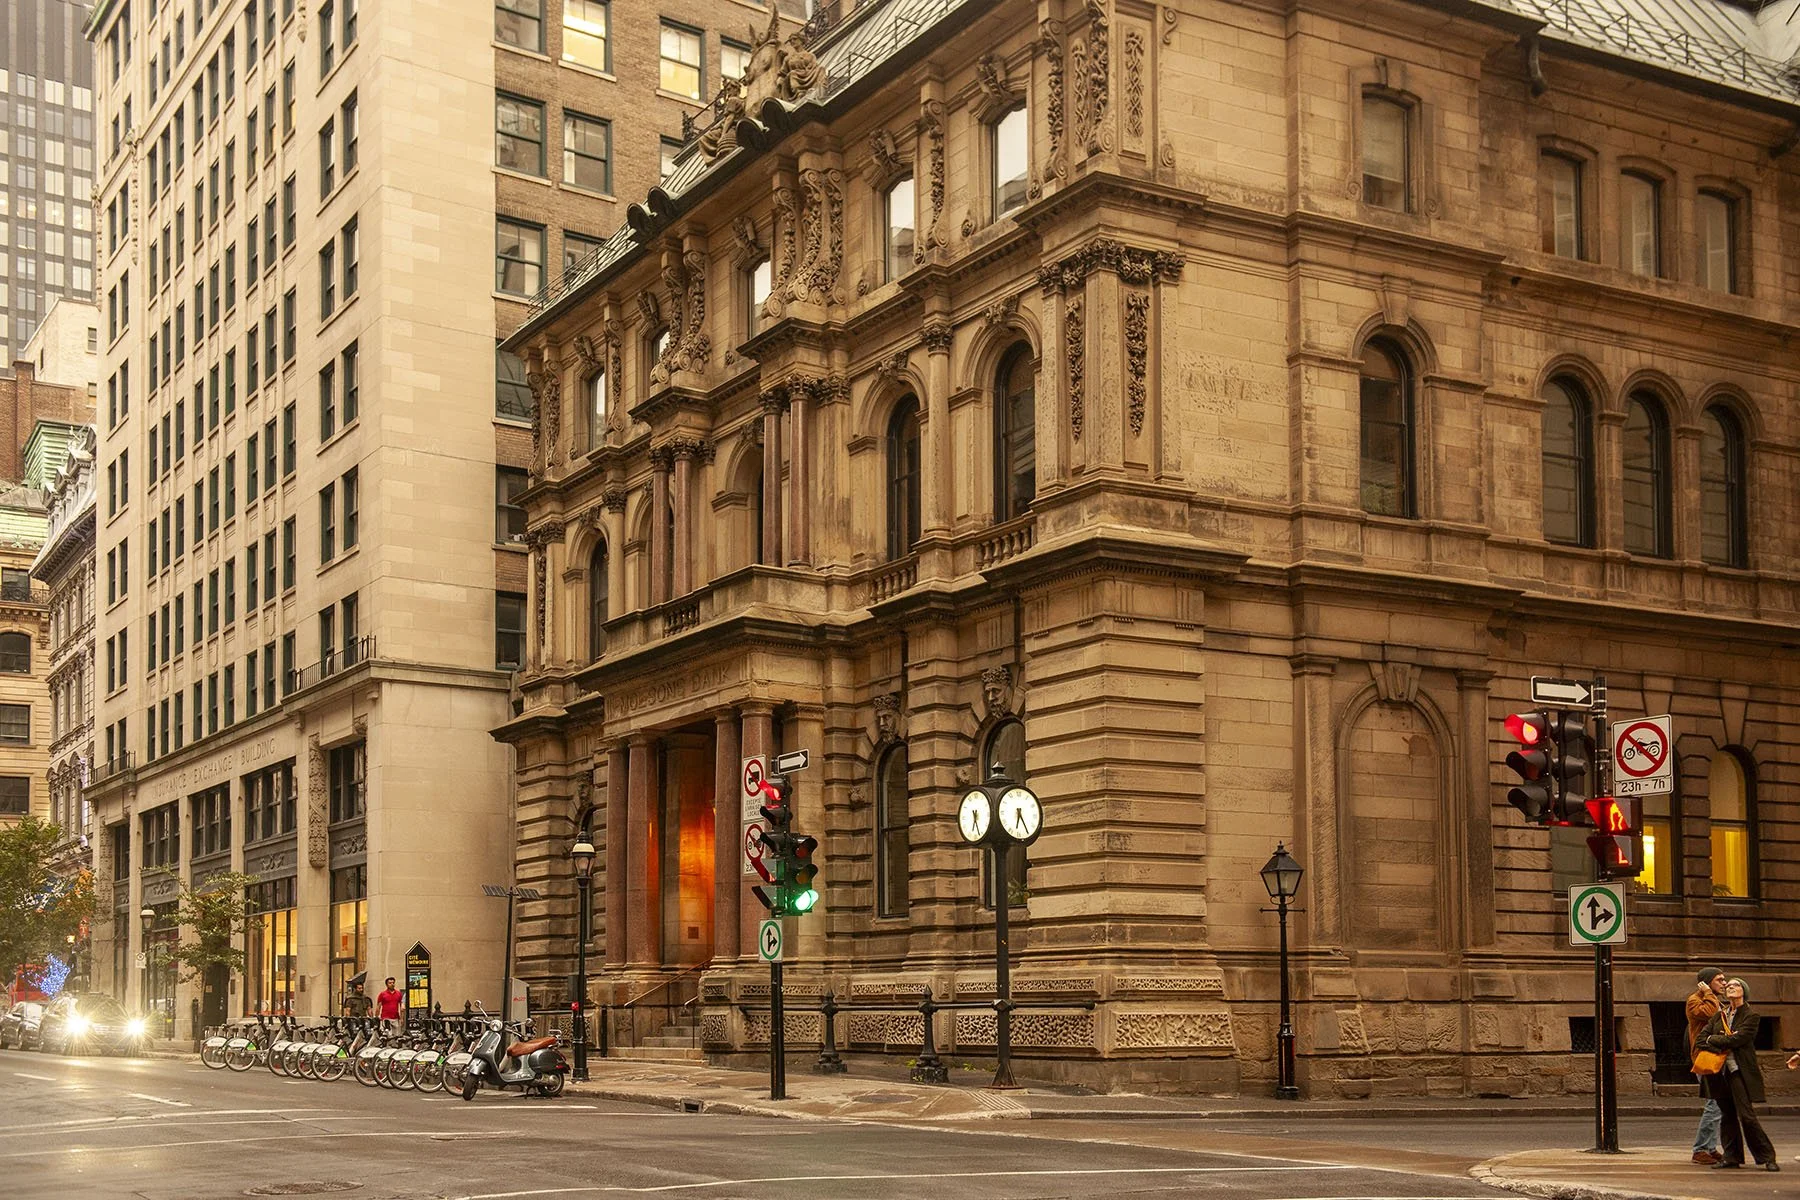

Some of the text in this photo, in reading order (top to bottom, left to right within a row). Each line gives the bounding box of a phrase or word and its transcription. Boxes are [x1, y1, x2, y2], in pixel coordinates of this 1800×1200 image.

[691, 664, 730, 693] BANK
[194, 755, 233, 784] EXCHANGE
[240, 738, 275, 766] BUILDING
[1621, 781, 1641, 793] 23h
[1651, 778, 1665, 790] 7h
